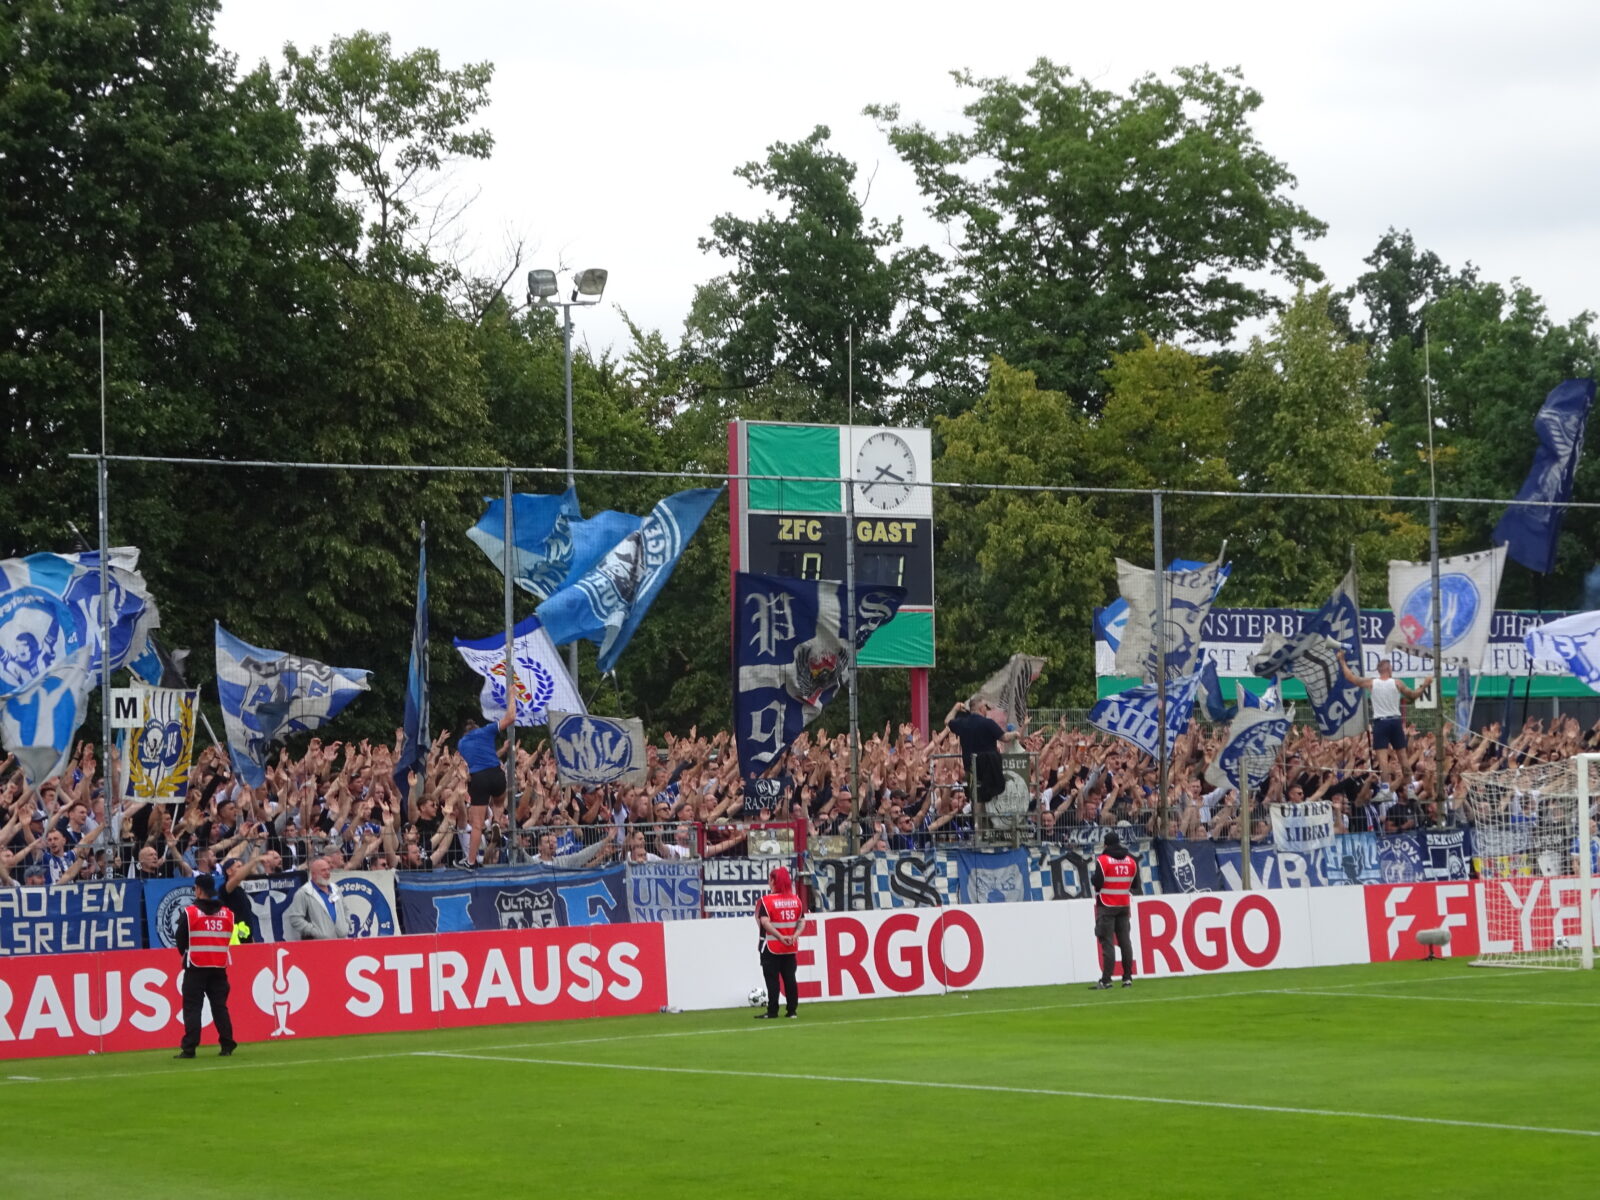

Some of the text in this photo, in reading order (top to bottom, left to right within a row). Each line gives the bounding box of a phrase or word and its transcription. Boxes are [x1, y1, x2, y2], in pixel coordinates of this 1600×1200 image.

[778, 519, 917, 543] ZFC GAST
[1418, 684, 1432, 702] N
[115, 697, 138, 719] M
[1115, 865, 1129, 875] 173
[632, 878, 701, 907] UNS
[502, 896, 549, 911] ULTRAS
[781, 910, 796, 920] 155
[204, 919, 223, 931] 135
[345, 942, 643, 1018] STRAUSS
